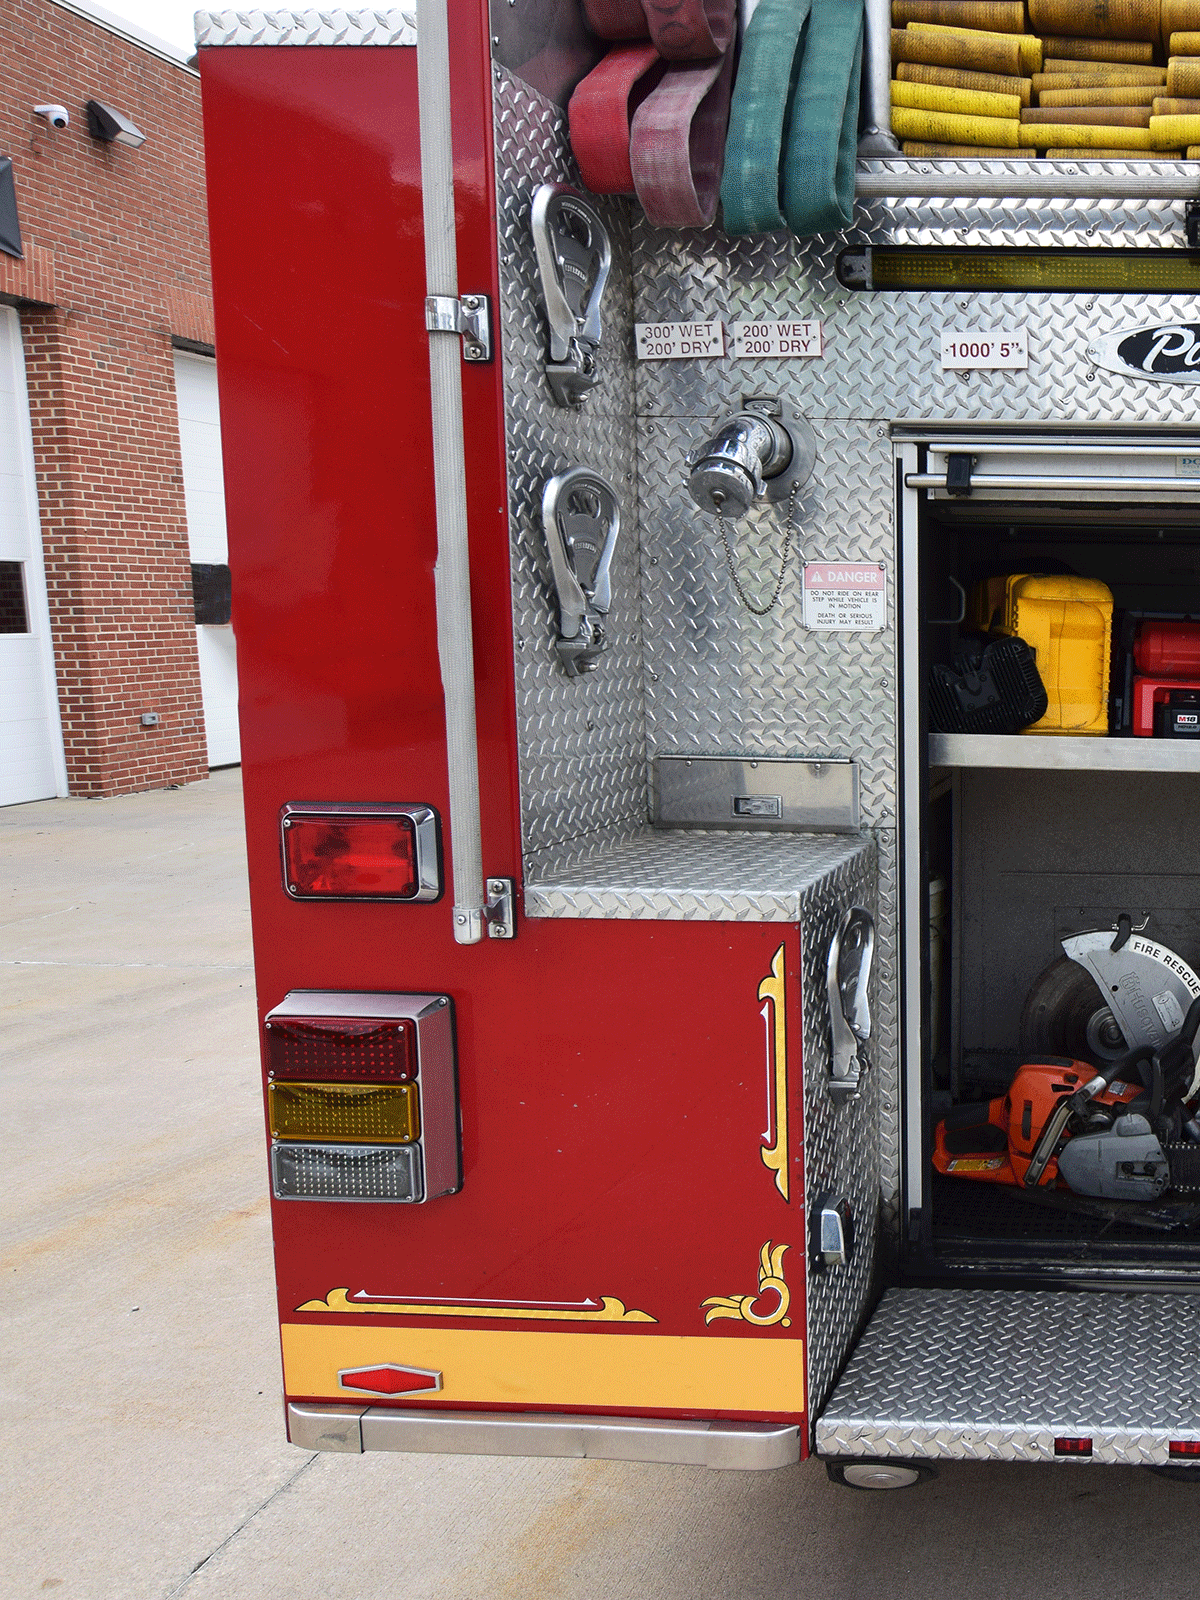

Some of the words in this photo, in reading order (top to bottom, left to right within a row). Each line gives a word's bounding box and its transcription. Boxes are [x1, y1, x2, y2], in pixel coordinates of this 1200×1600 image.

[644, 325, 674, 339] 300'
[679, 324, 714, 338] WET
[743, 325, 772, 338] 200'
[776, 324, 812, 337] WET
[646, 342, 676, 356] 200'
[681, 340, 712, 354] DRY
[745, 340, 774, 354] 200'
[779, 340, 811, 352] DRY
[950, 342, 994, 358] 1000'
[828, 571, 878, 583] DANGER
[1134, 942, 1161, 958] FIRE
[1163, 954, 1200, 994] RESCUE
